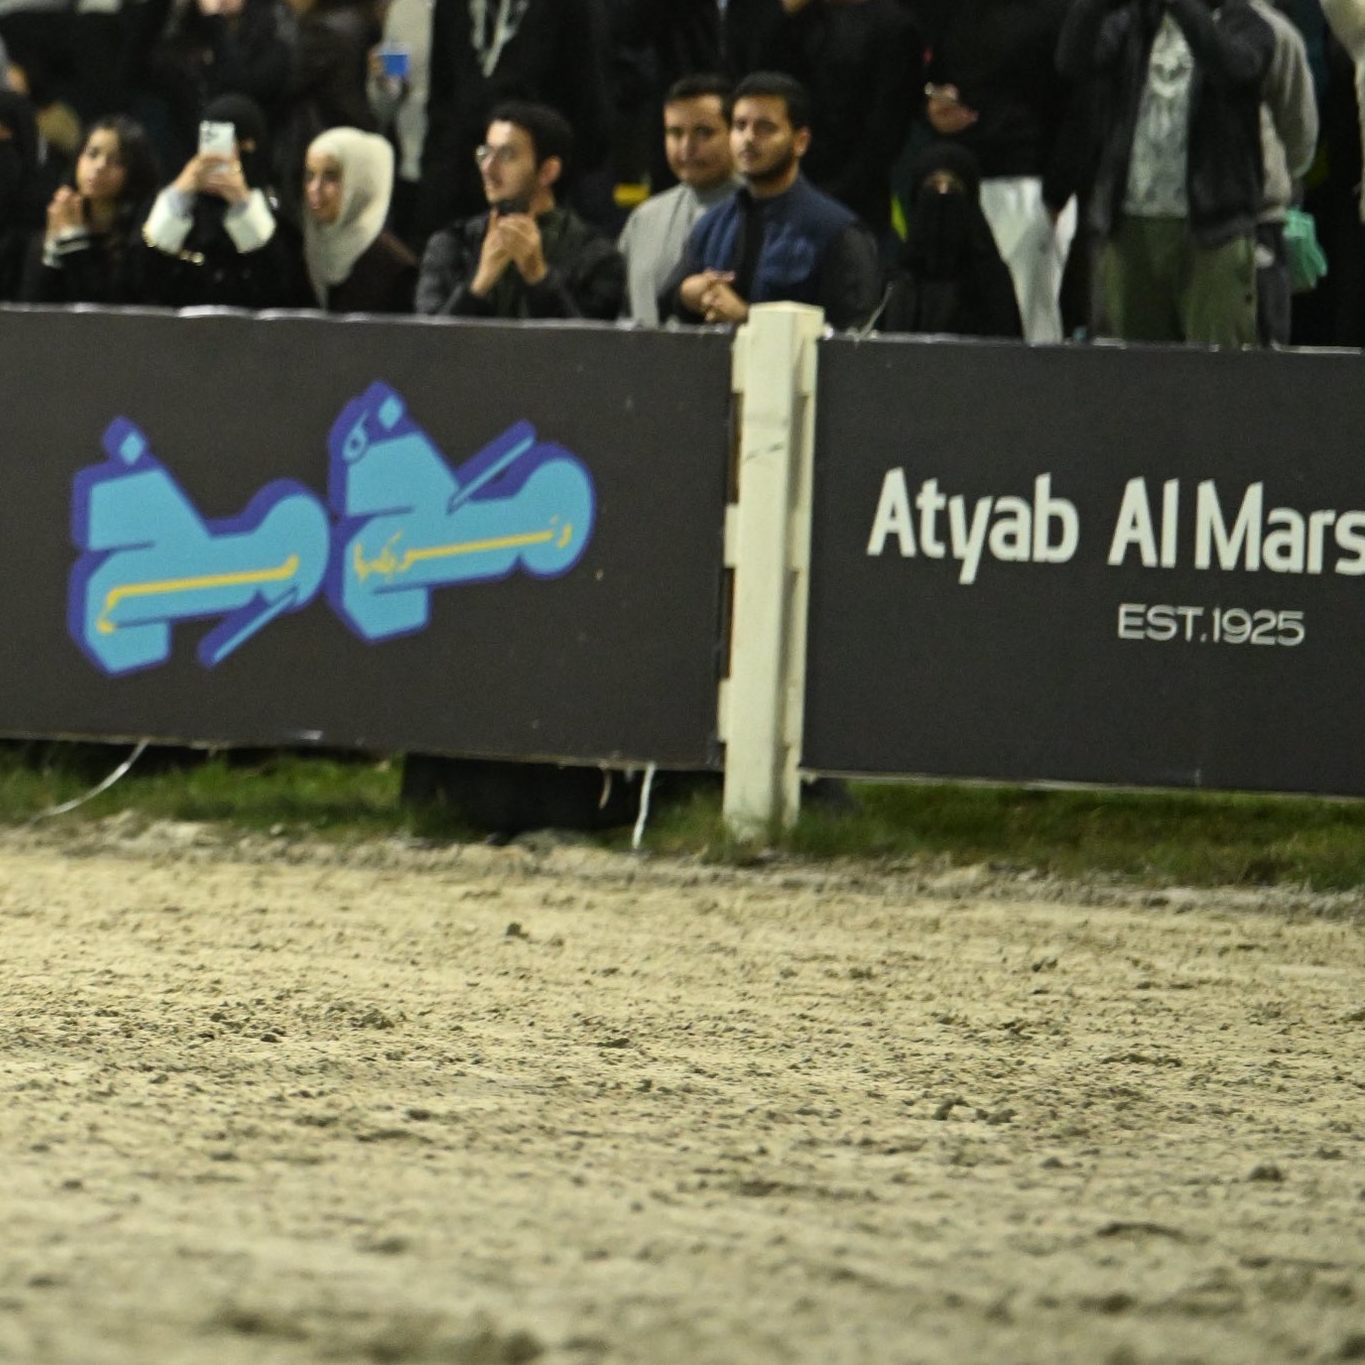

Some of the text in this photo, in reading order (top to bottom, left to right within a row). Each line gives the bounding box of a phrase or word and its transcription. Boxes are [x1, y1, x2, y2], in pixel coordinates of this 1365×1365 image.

[867, 466, 1365, 585] Atyab Al Mars
[1117, 603, 1306, 647] EST.1925
